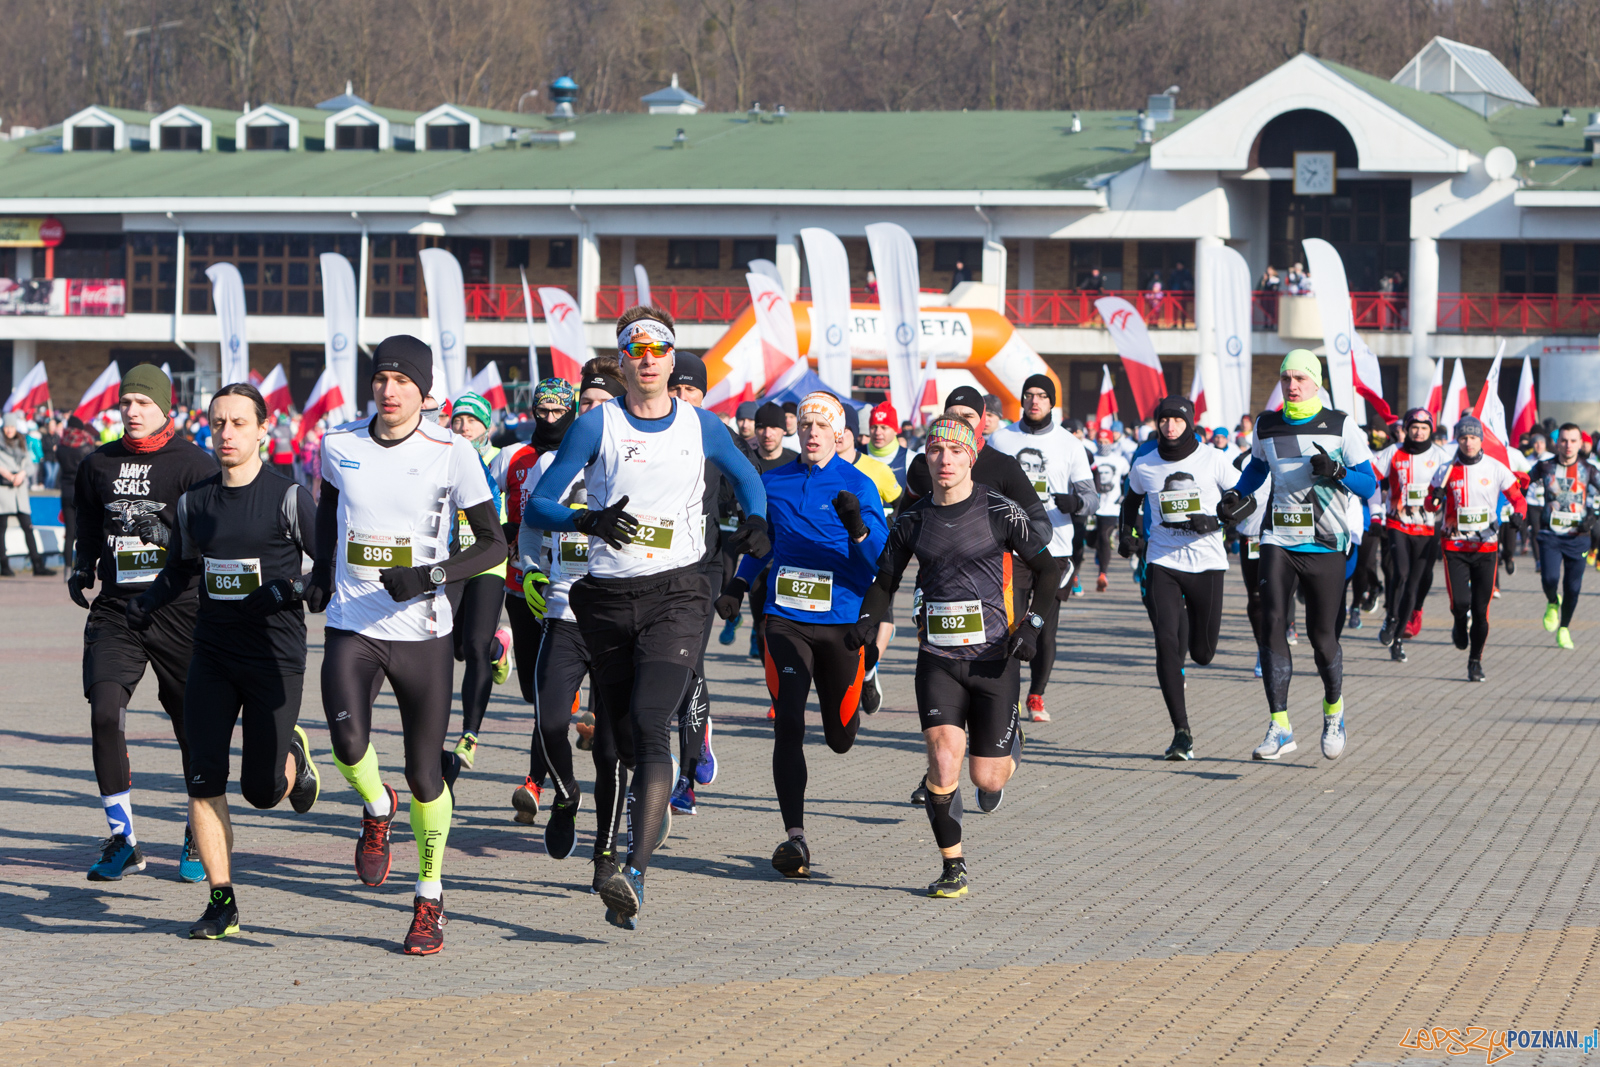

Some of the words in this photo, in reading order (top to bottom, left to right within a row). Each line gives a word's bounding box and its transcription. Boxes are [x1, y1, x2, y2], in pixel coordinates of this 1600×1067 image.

[119, 462, 152, 480] NAVY
[112, 479, 151, 496] SEALS
[1171, 500, 1189, 510] 359
[1283, 513, 1302, 524] 943
[1467, 514, 1481, 523] 370
[132, 551, 158, 565] 704
[363, 546, 393, 562] 896
[215, 575, 241, 589] 864
[792, 580, 815, 595] 827
[941, 616, 966, 629] 892
